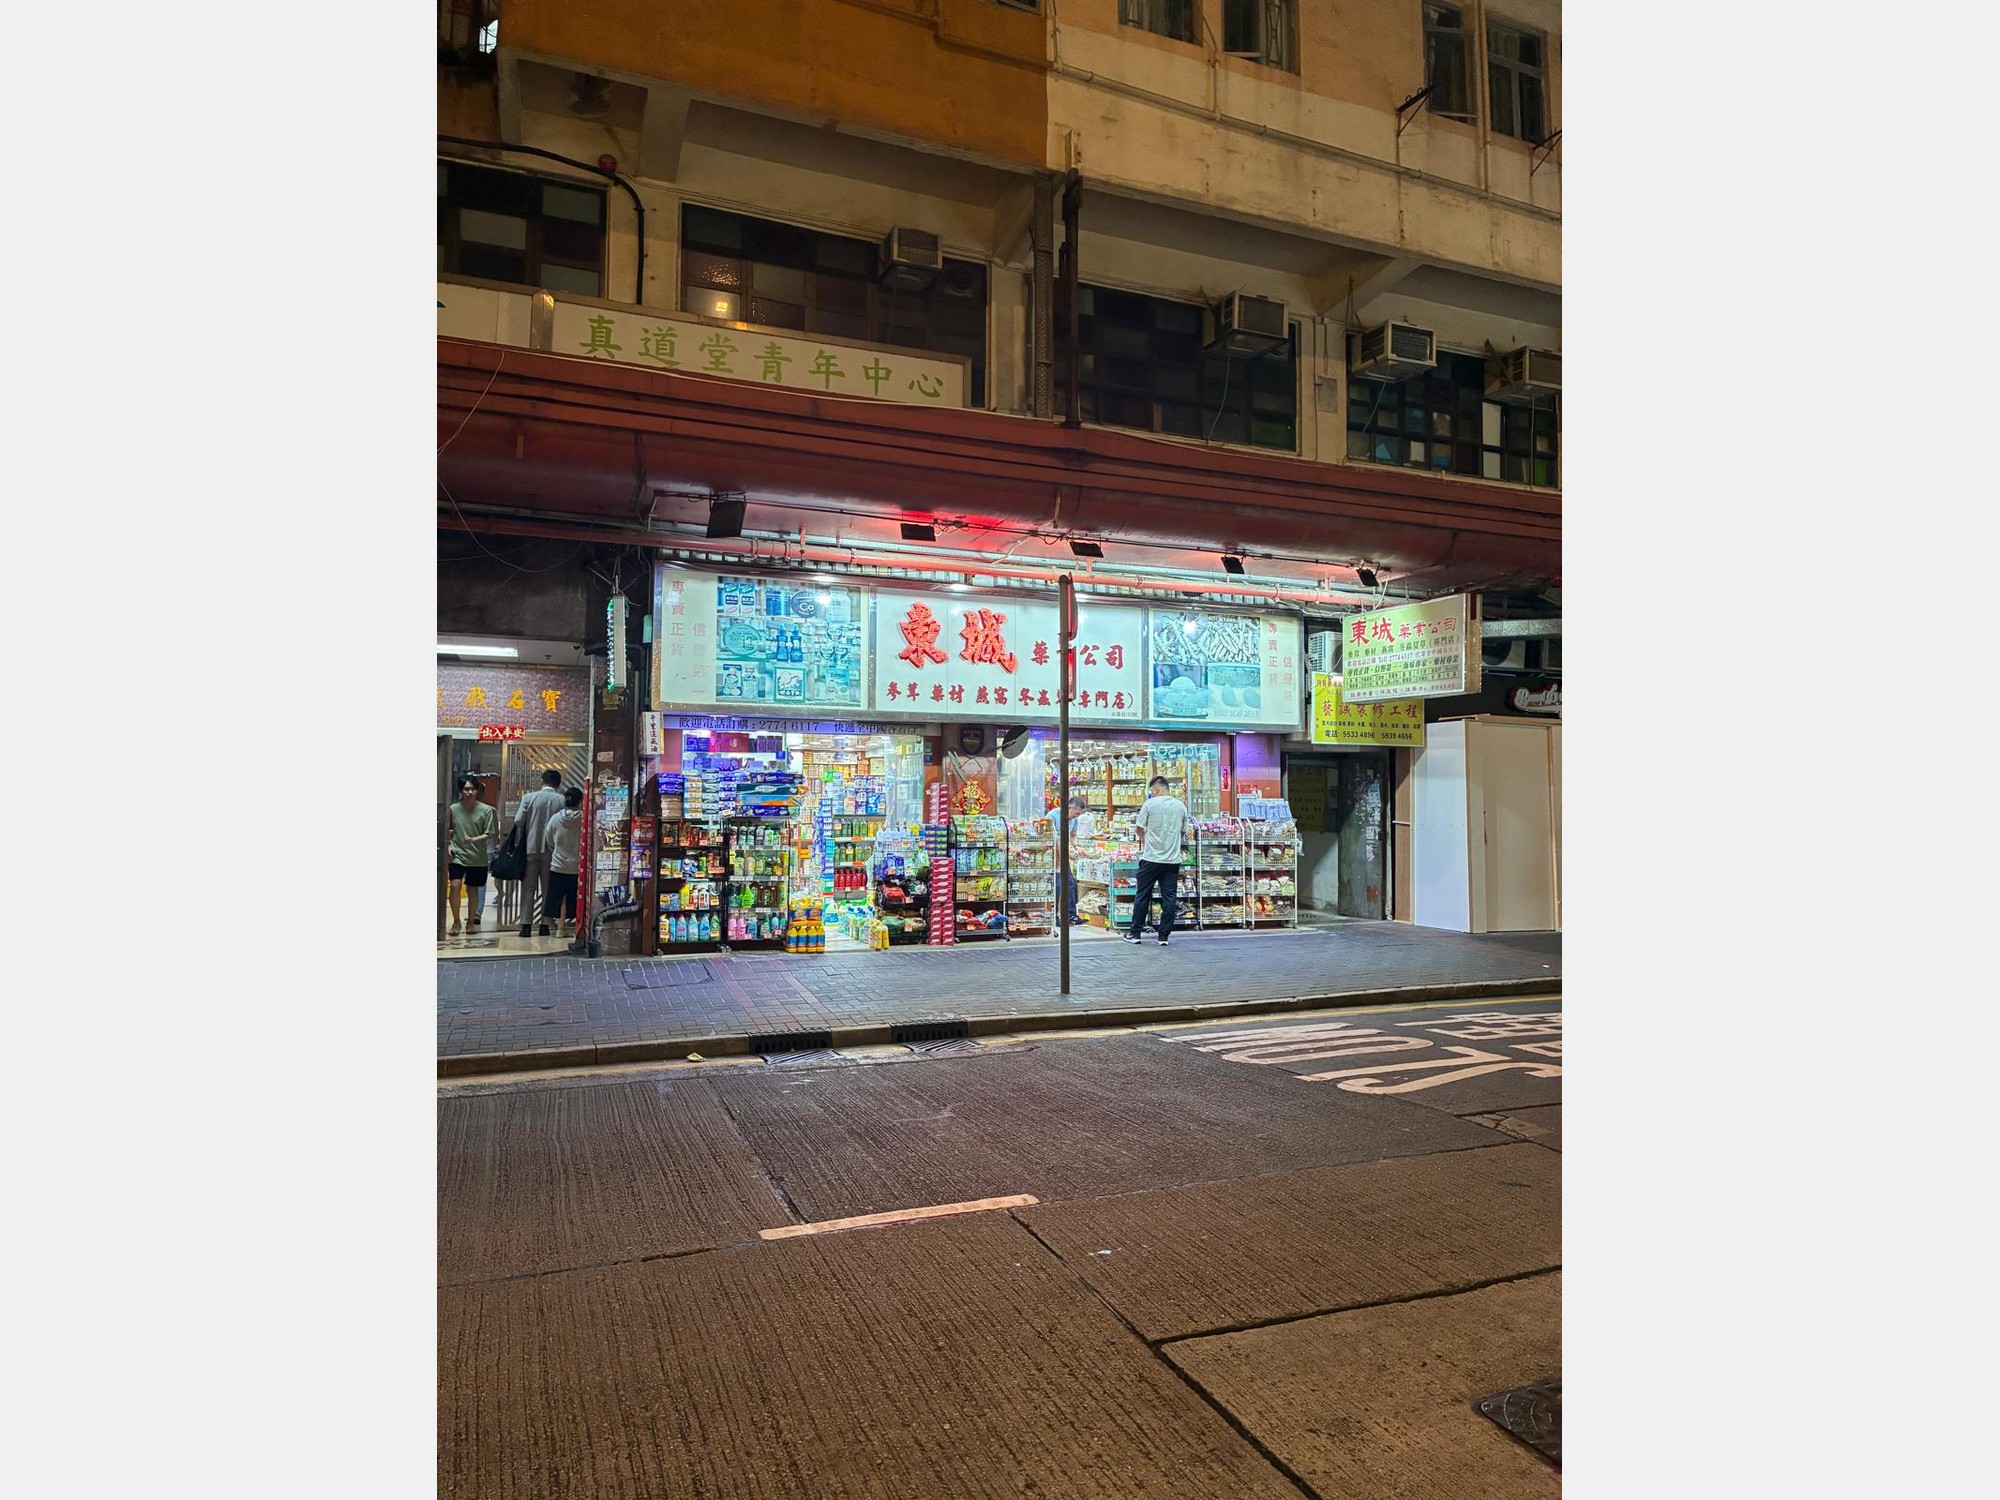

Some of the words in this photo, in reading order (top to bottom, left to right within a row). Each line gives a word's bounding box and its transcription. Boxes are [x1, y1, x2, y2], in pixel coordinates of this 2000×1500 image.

[579, 315, 944, 399] 真道堂青年中心
[898, 601, 1019, 674] 東城
[1030, 641, 1124, 671] 藥公司
[1349, 616, 1395, 647] 東城
[482, 726, 524, 740] 出入平安
[759, 720, 788, 732] 2774
[791, 721, 820, 732] 6117
[1343, 730, 1358, 738] 5533
[1360, 731, 1375, 739] 4896
